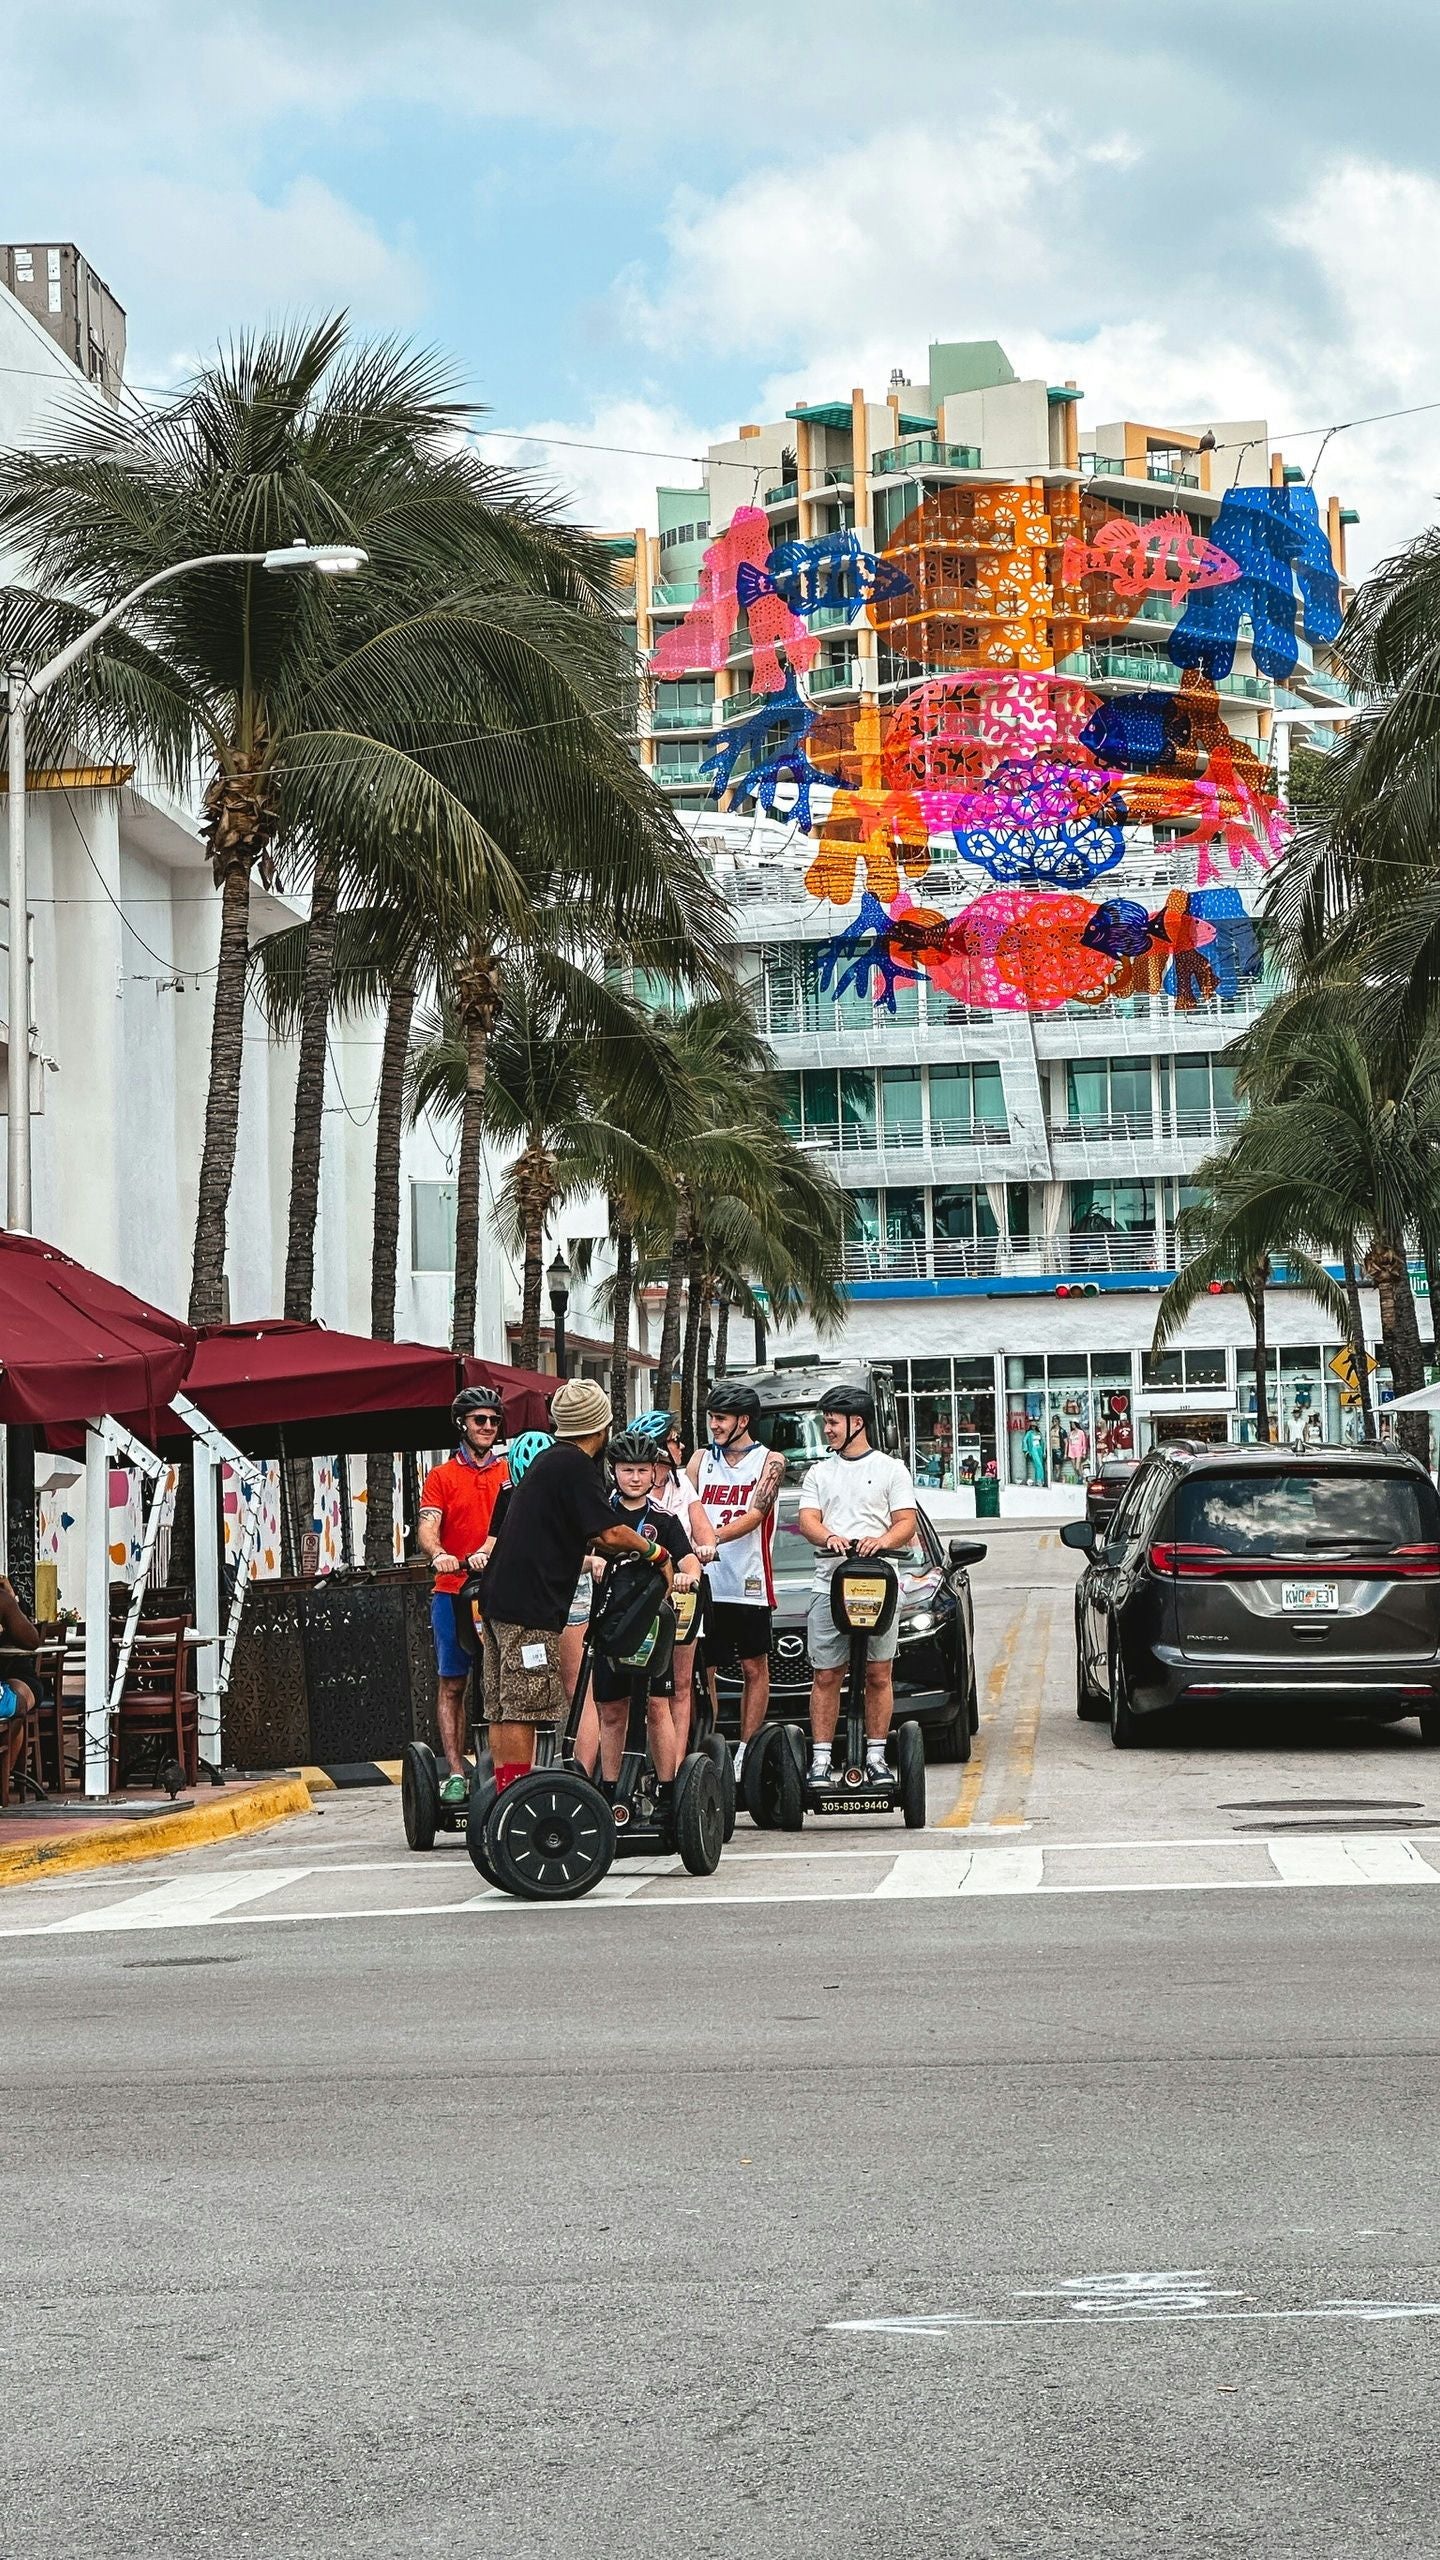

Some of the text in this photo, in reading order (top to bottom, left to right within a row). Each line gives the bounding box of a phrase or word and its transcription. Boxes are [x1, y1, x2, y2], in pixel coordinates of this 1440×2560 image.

[701, 1484, 755, 1506] HEAT
[716, 1509, 748, 1529] 3
[821, 1800, 889, 1812] 305-830-9440
